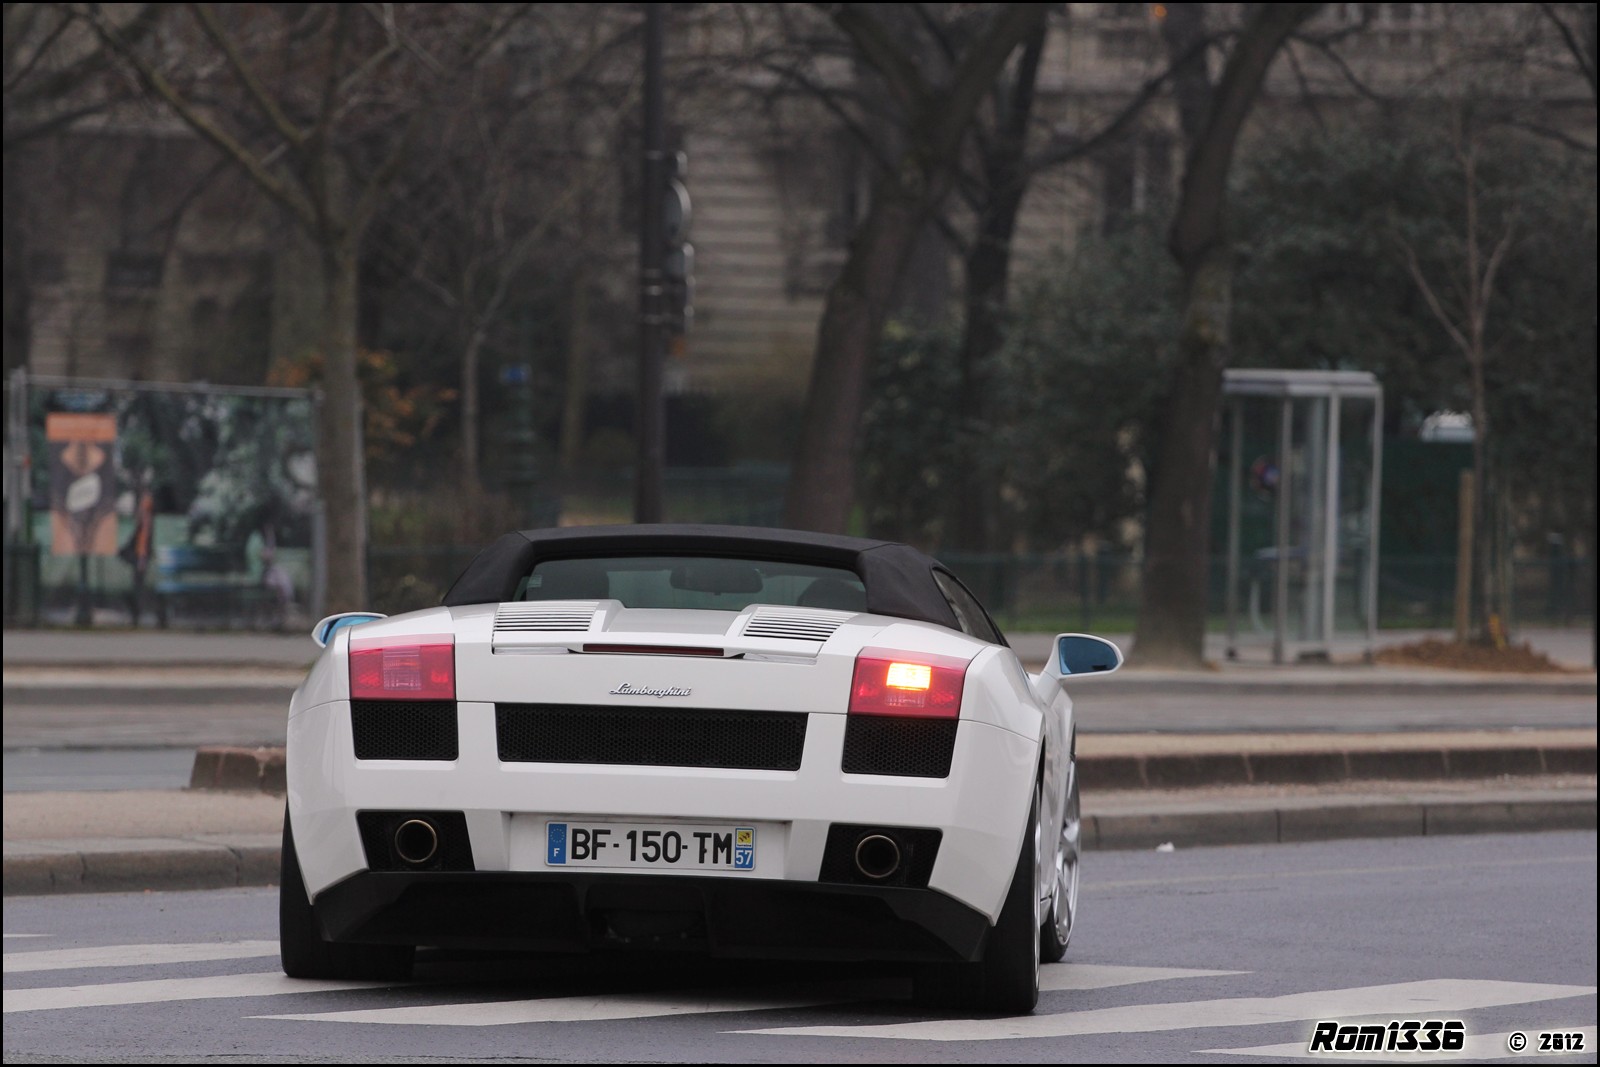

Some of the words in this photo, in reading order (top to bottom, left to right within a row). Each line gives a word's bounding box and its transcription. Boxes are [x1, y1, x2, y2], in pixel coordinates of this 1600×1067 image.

[609, 682, 691, 699] Lamborghini
[553, 847, 560, 857] F
[735, 849, 752, 865] 57
